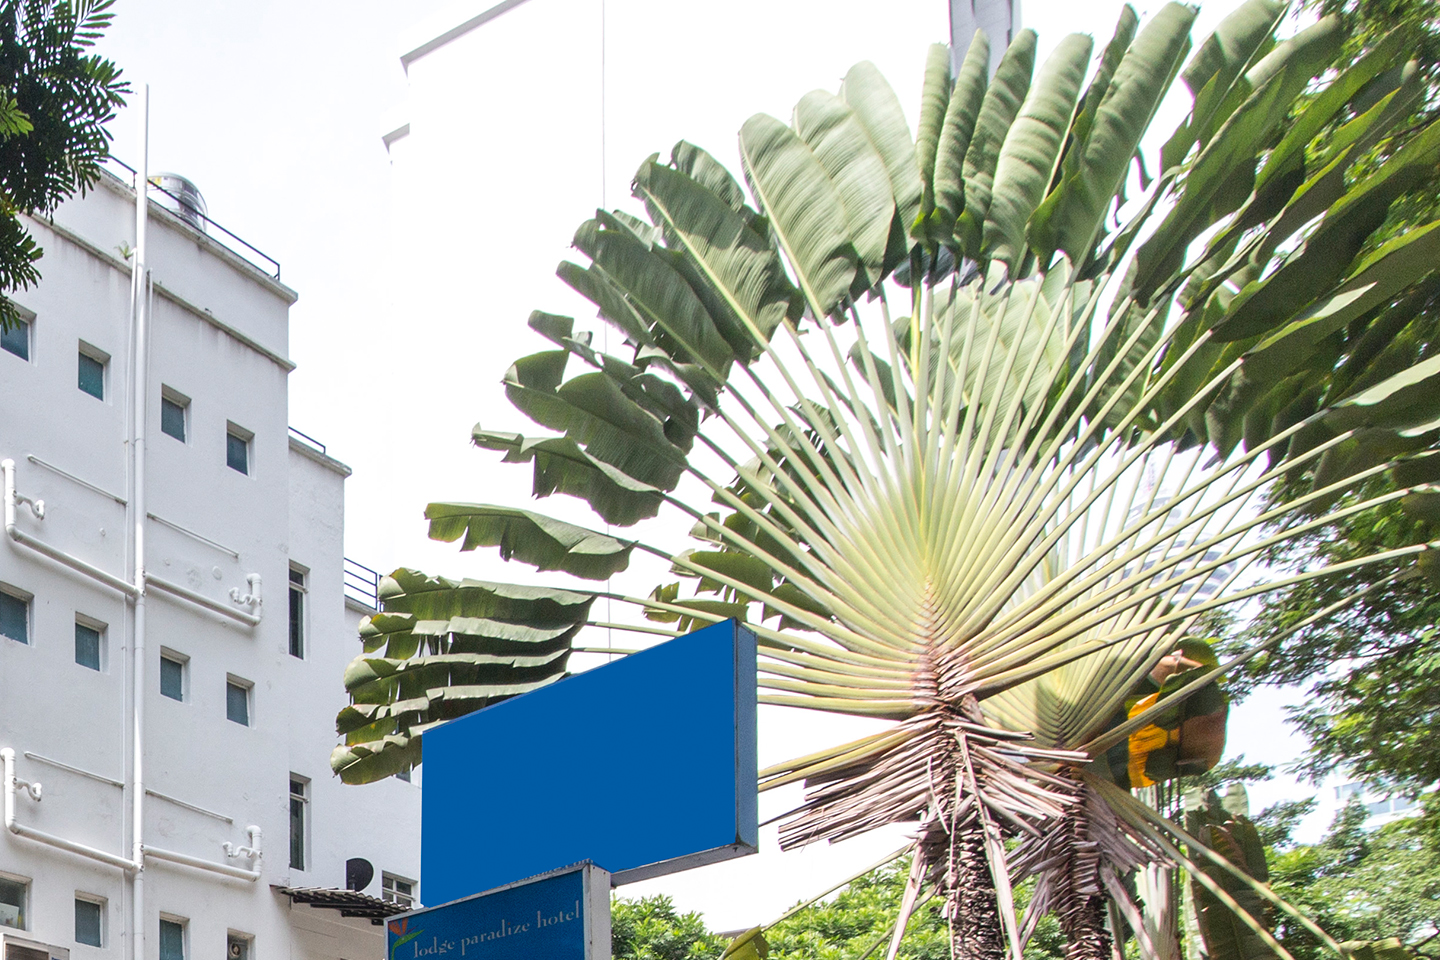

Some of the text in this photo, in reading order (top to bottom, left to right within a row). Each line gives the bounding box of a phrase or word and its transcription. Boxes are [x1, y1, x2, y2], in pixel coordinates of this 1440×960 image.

[413, 900, 580, 958] lodge paradize hotel
